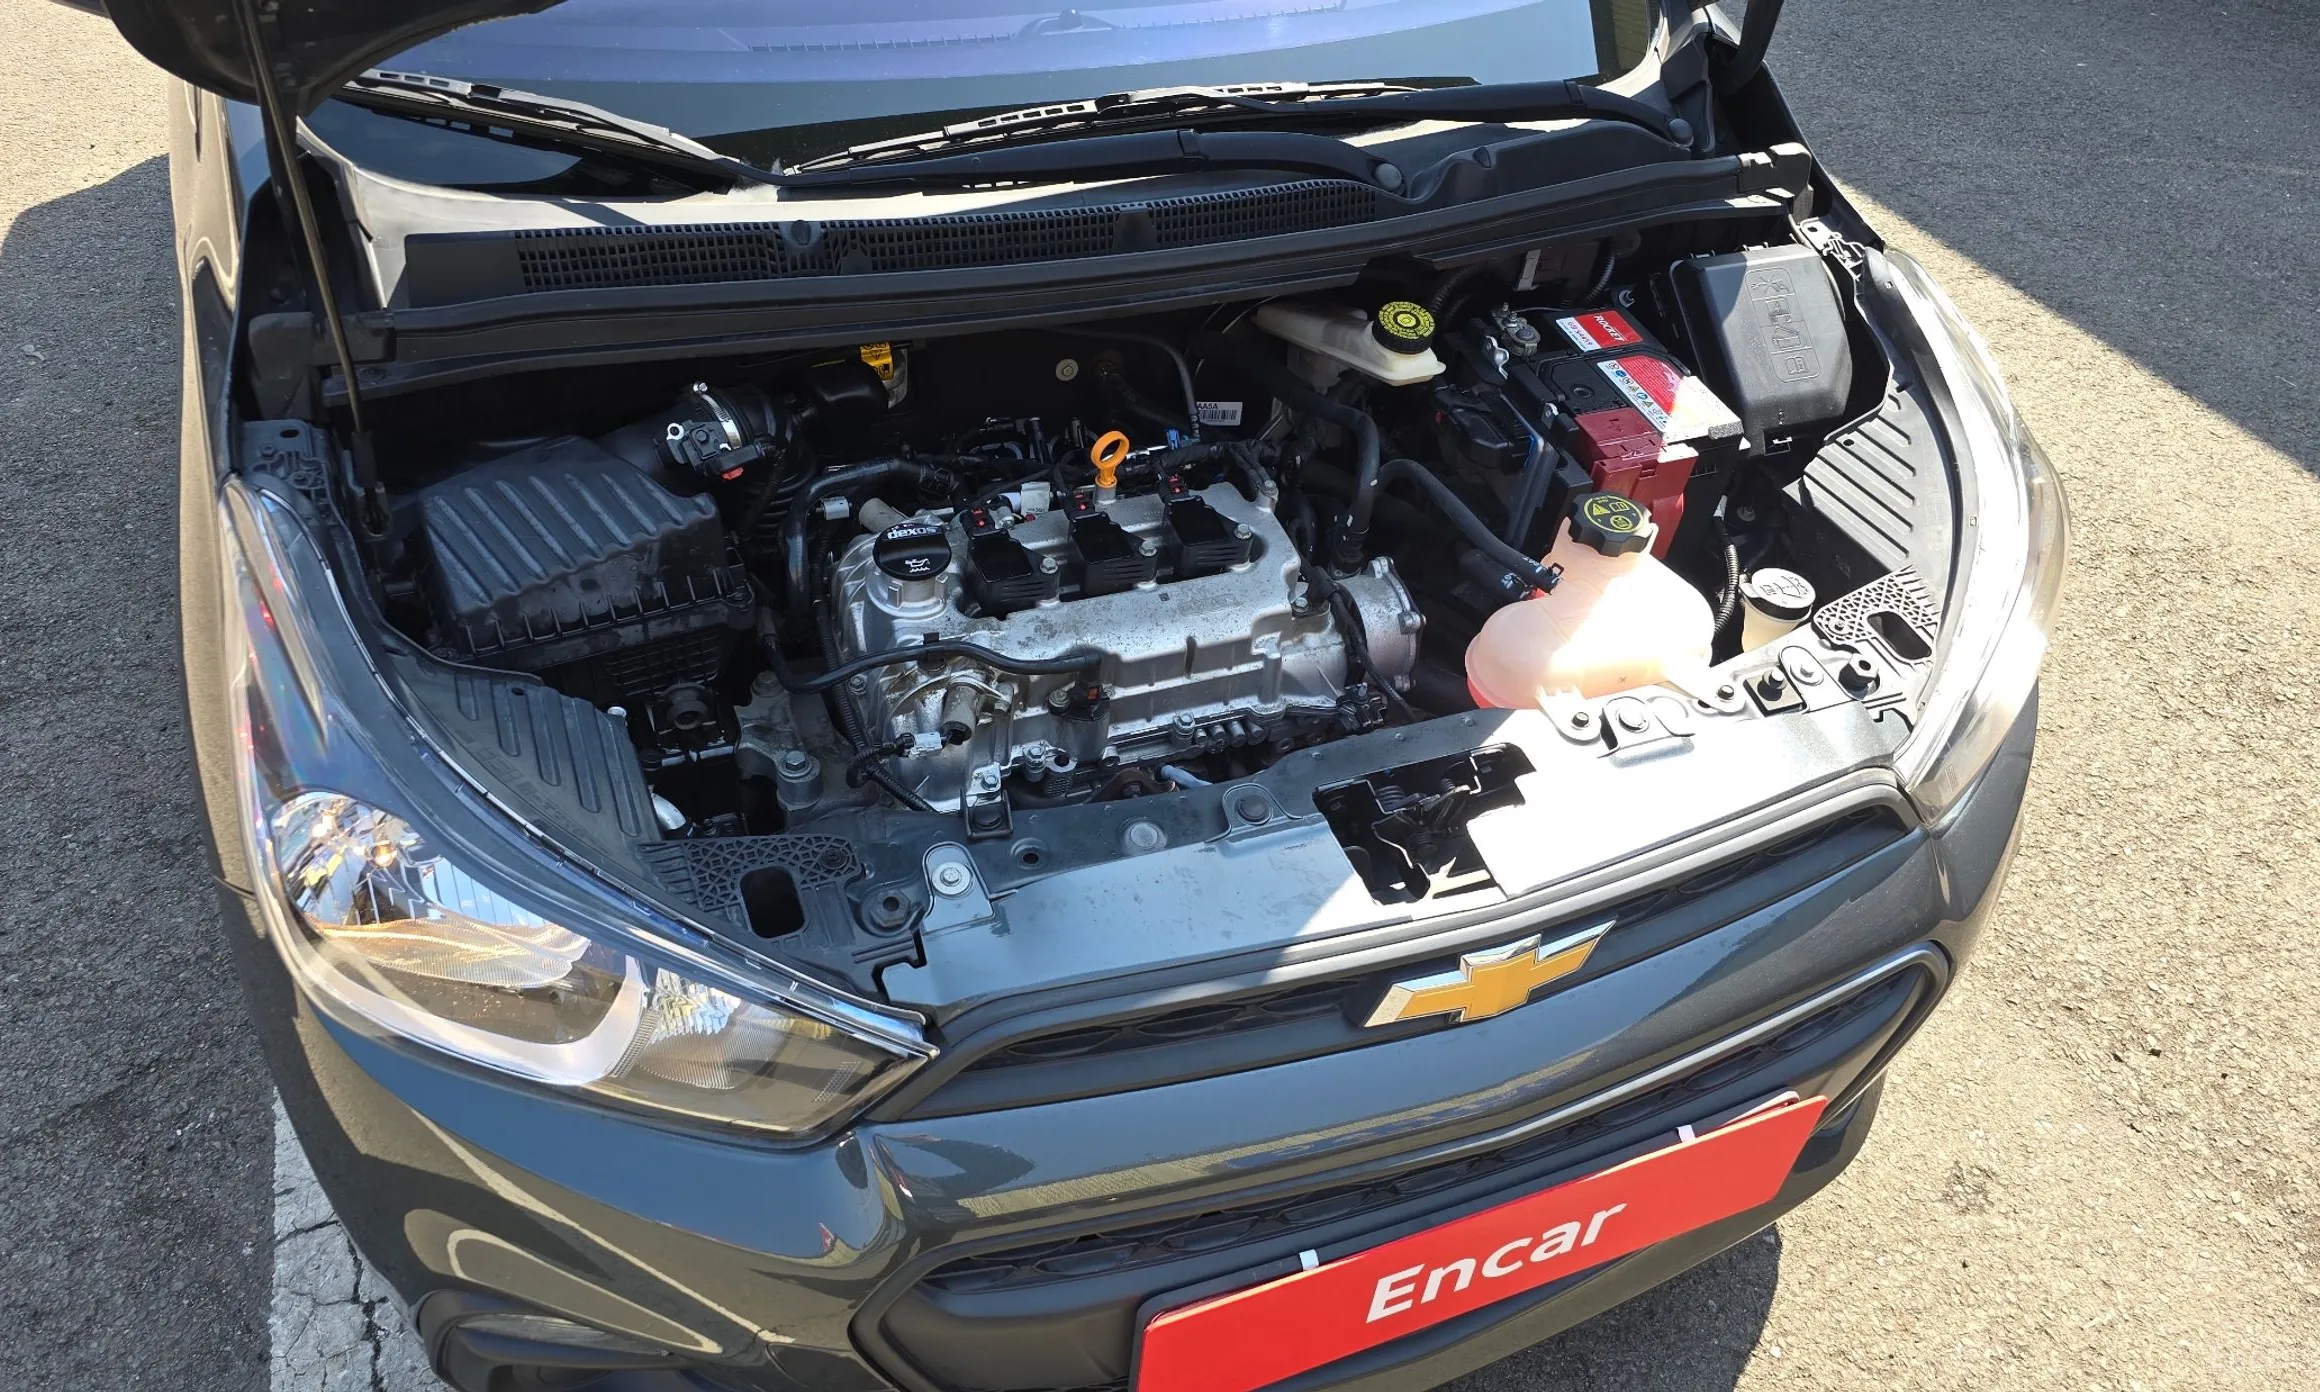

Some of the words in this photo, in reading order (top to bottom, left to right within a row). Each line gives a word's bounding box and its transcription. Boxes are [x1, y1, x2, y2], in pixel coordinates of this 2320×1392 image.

[1594, 315, 1625, 341] ROCKET
[887, 527, 938, 540] dexos
[1365, 1203, 1627, 1324] Encar
